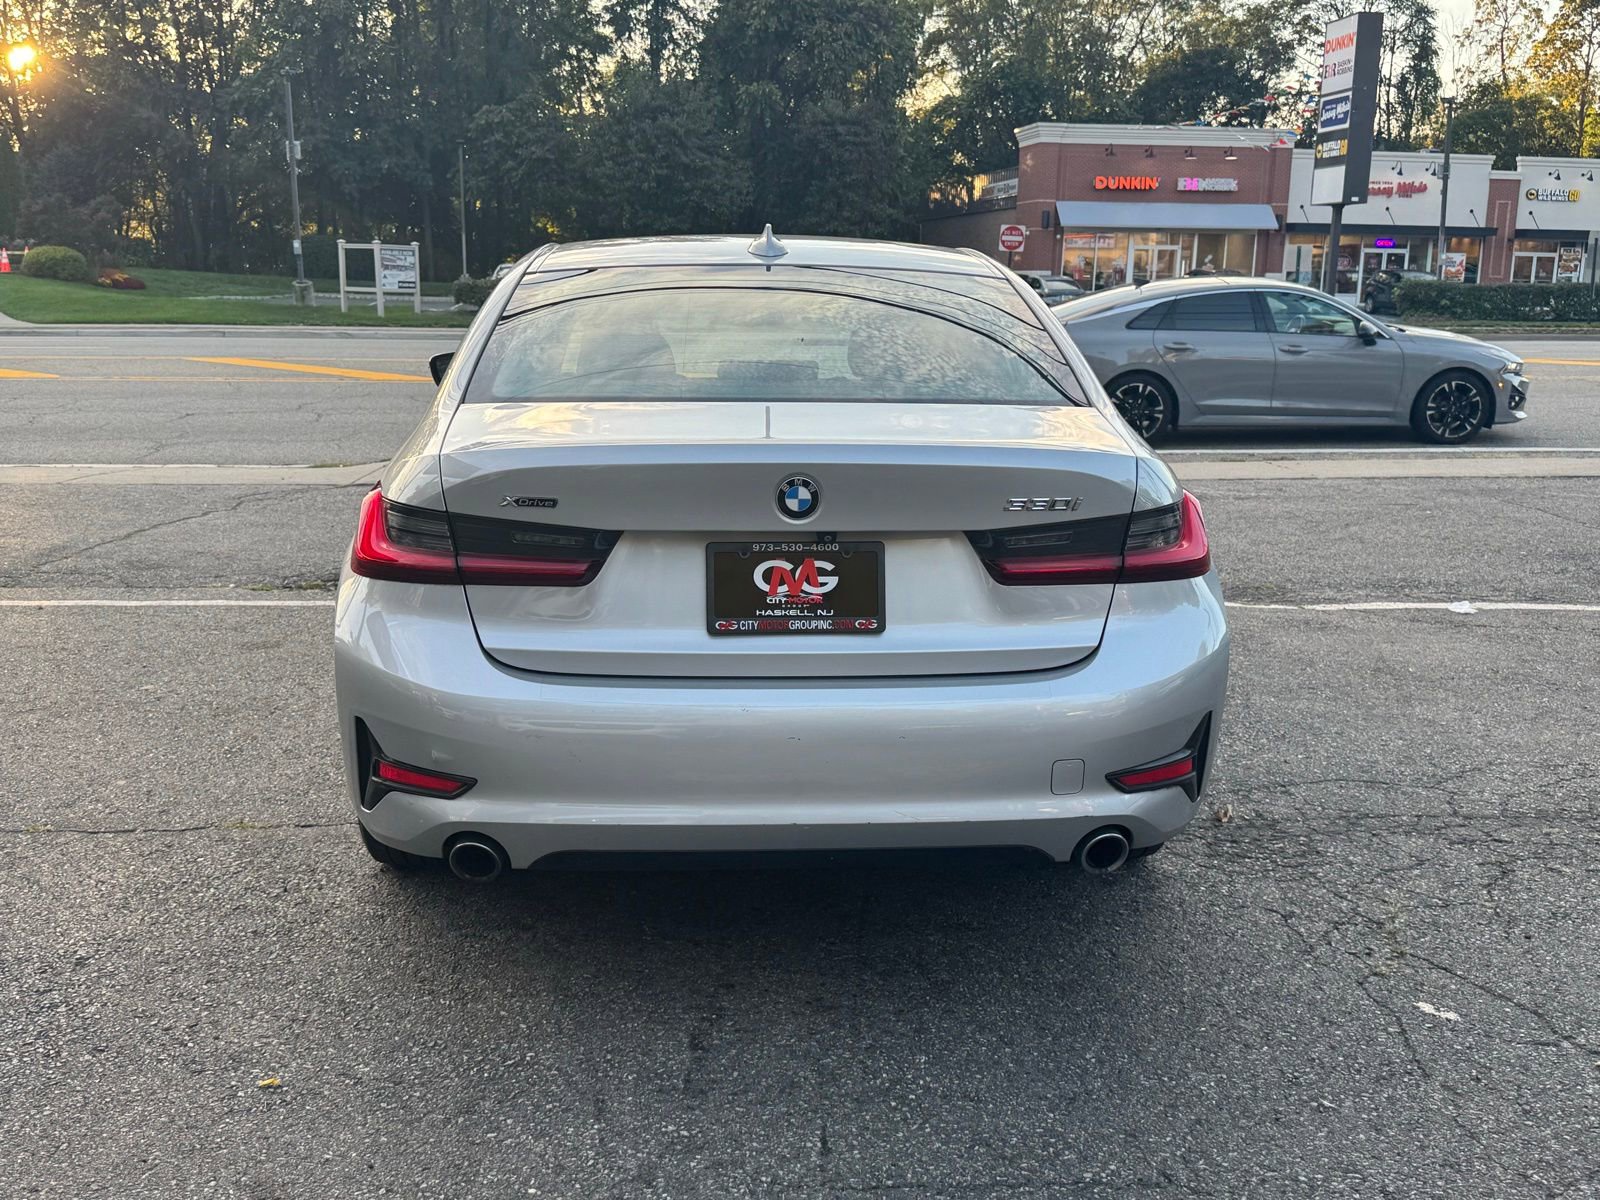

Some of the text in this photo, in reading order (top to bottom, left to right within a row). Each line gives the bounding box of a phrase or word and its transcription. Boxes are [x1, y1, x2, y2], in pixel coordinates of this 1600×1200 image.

[1325, 32, 1357, 54] DUNKIN'
[1095, 176, 1161, 190] DUNKIN'
[1537, 188, 1569, 196] BUFFALO
[1003, 496, 1083, 511] 330i
[752, 543, 839, 551] 973-530-4600
[756, 609, 814, 617] HASKELL,
